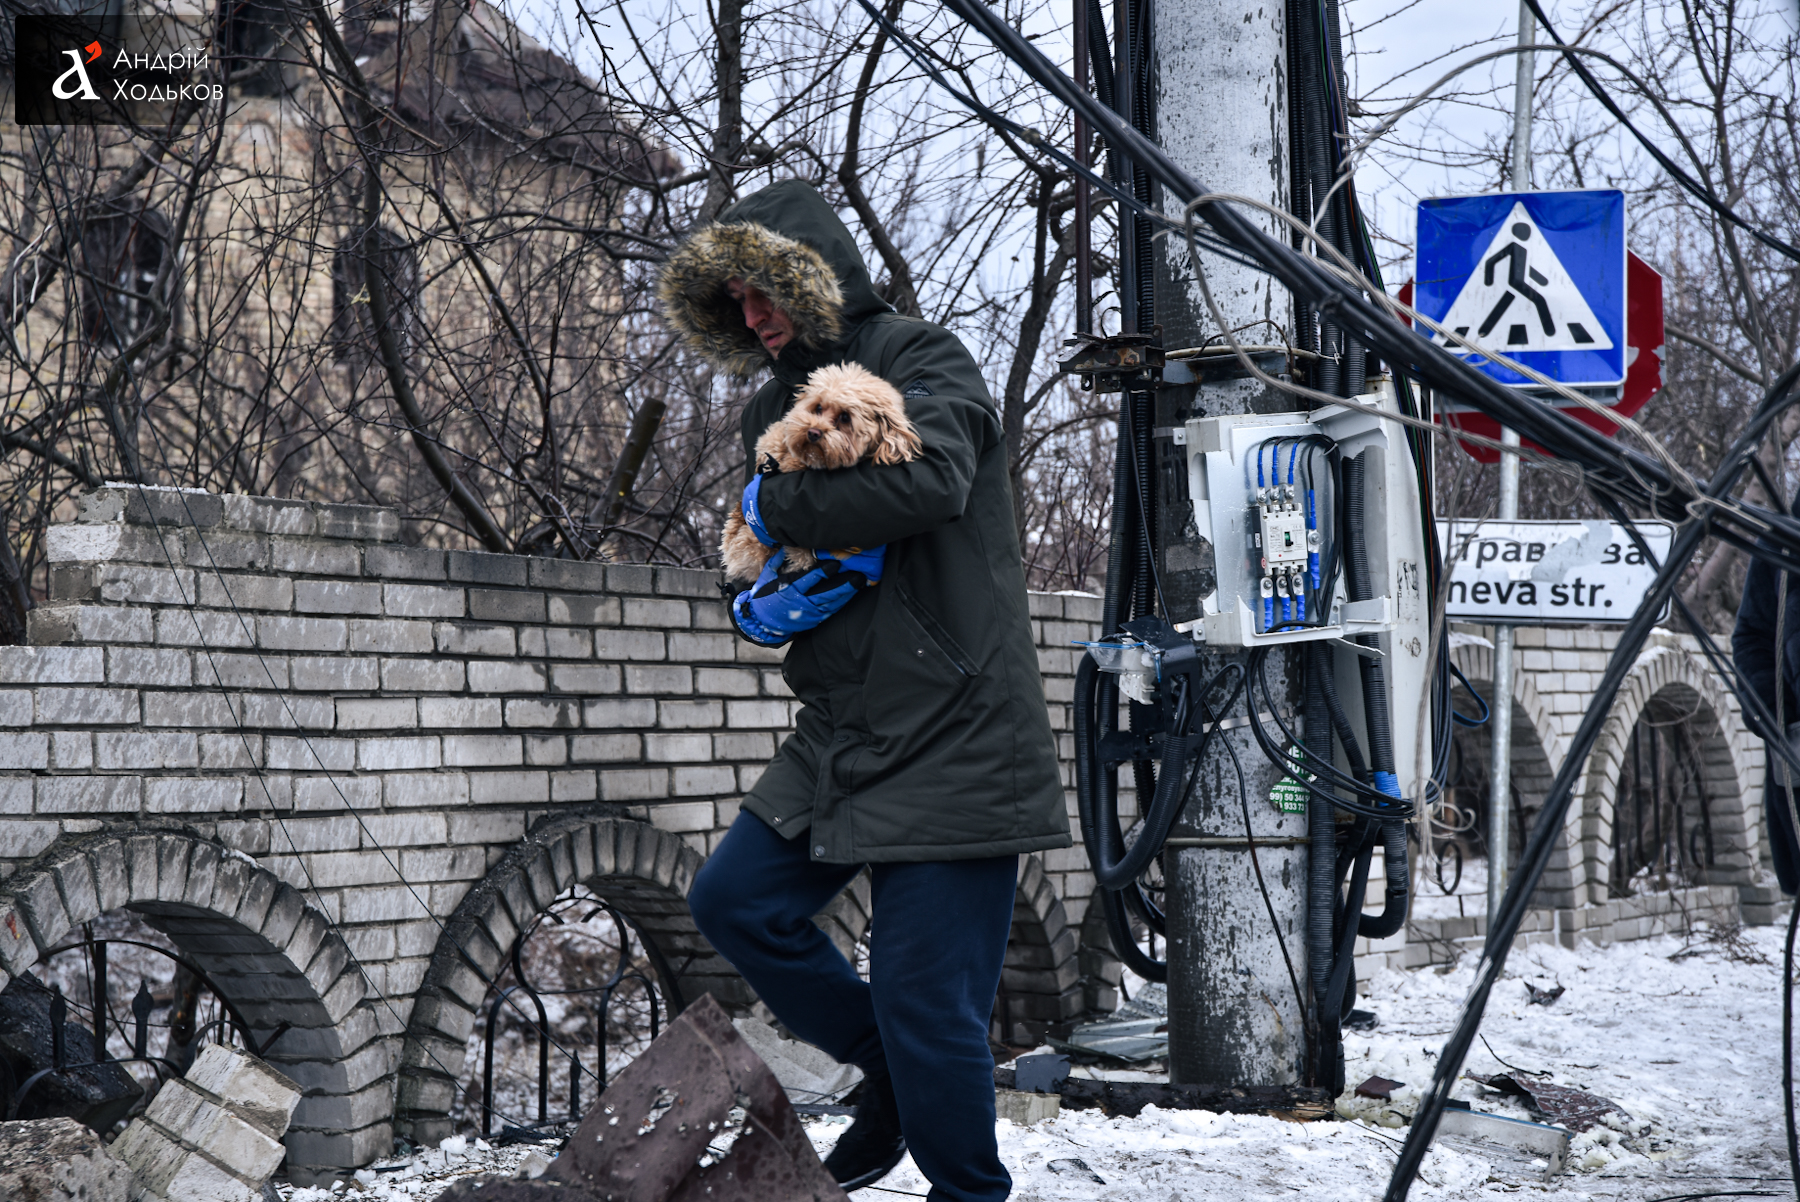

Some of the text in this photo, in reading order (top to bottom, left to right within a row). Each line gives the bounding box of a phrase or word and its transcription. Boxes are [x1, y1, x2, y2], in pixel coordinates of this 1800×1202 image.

[1456, 533, 1647, 569] Травва
[1551, 577, 1613, 608] str.
[1284, 793, 1294, 801] 50
[1284, 802, 1297, 811] 933
